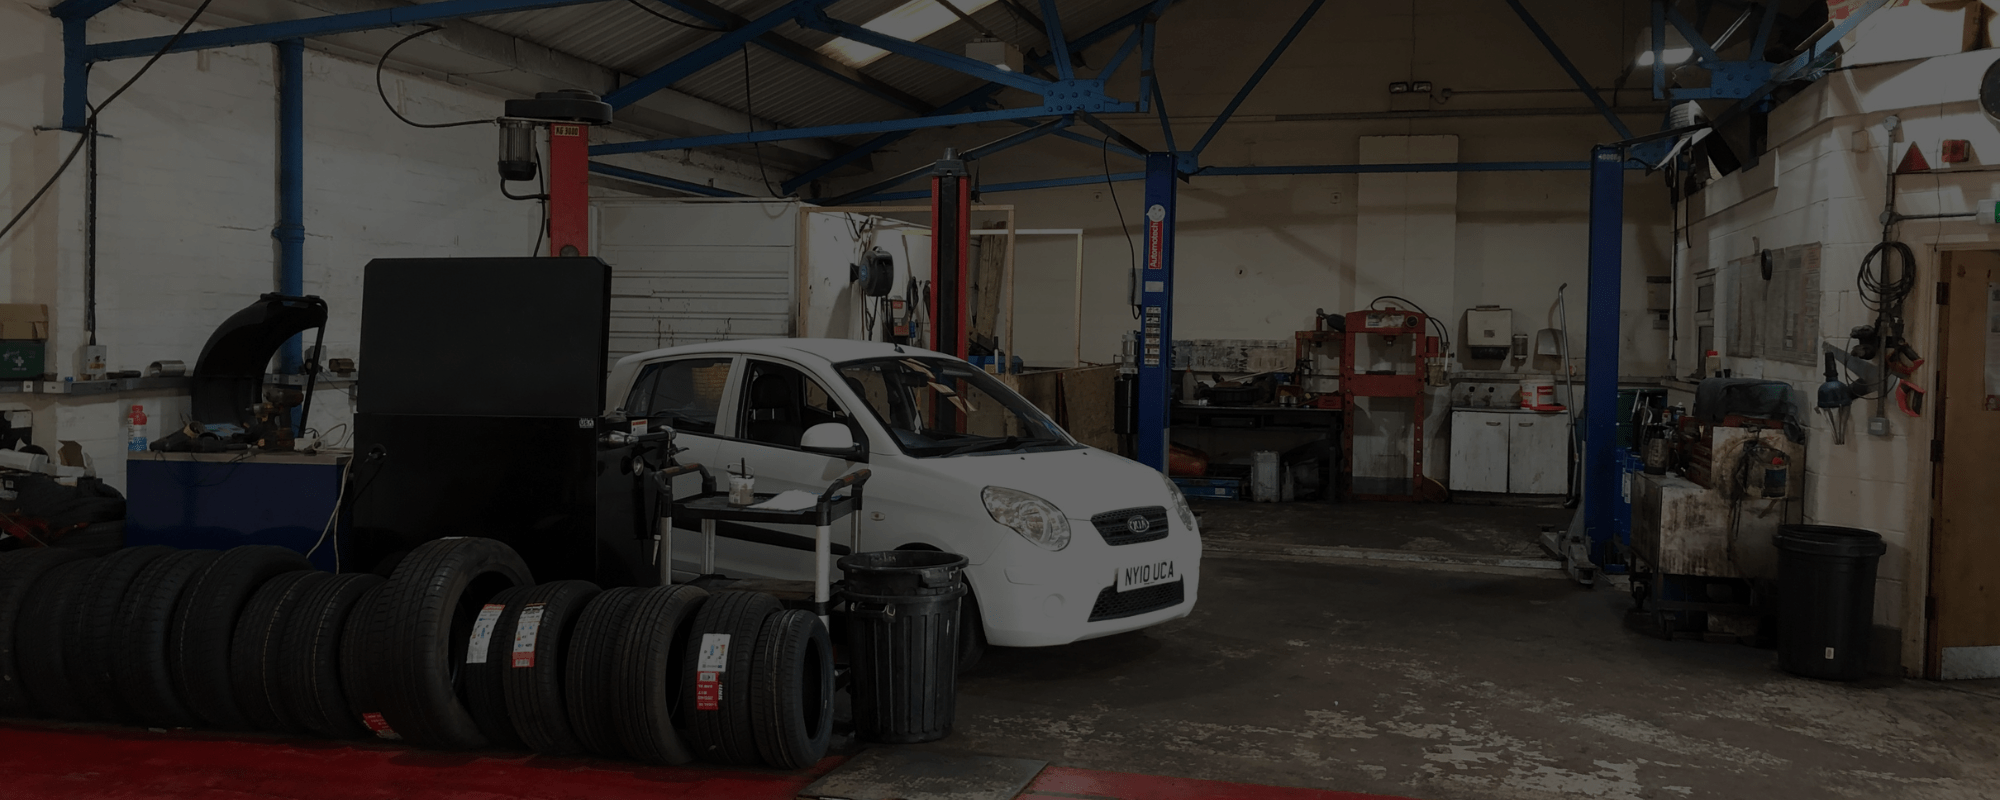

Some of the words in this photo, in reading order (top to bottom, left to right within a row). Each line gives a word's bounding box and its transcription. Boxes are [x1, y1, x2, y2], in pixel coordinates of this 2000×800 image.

[1149, 222, 1158, 267] Automotech
[1125, 564, 1150, 586] NY10
[1153, 560, 1174, 580] UCA
